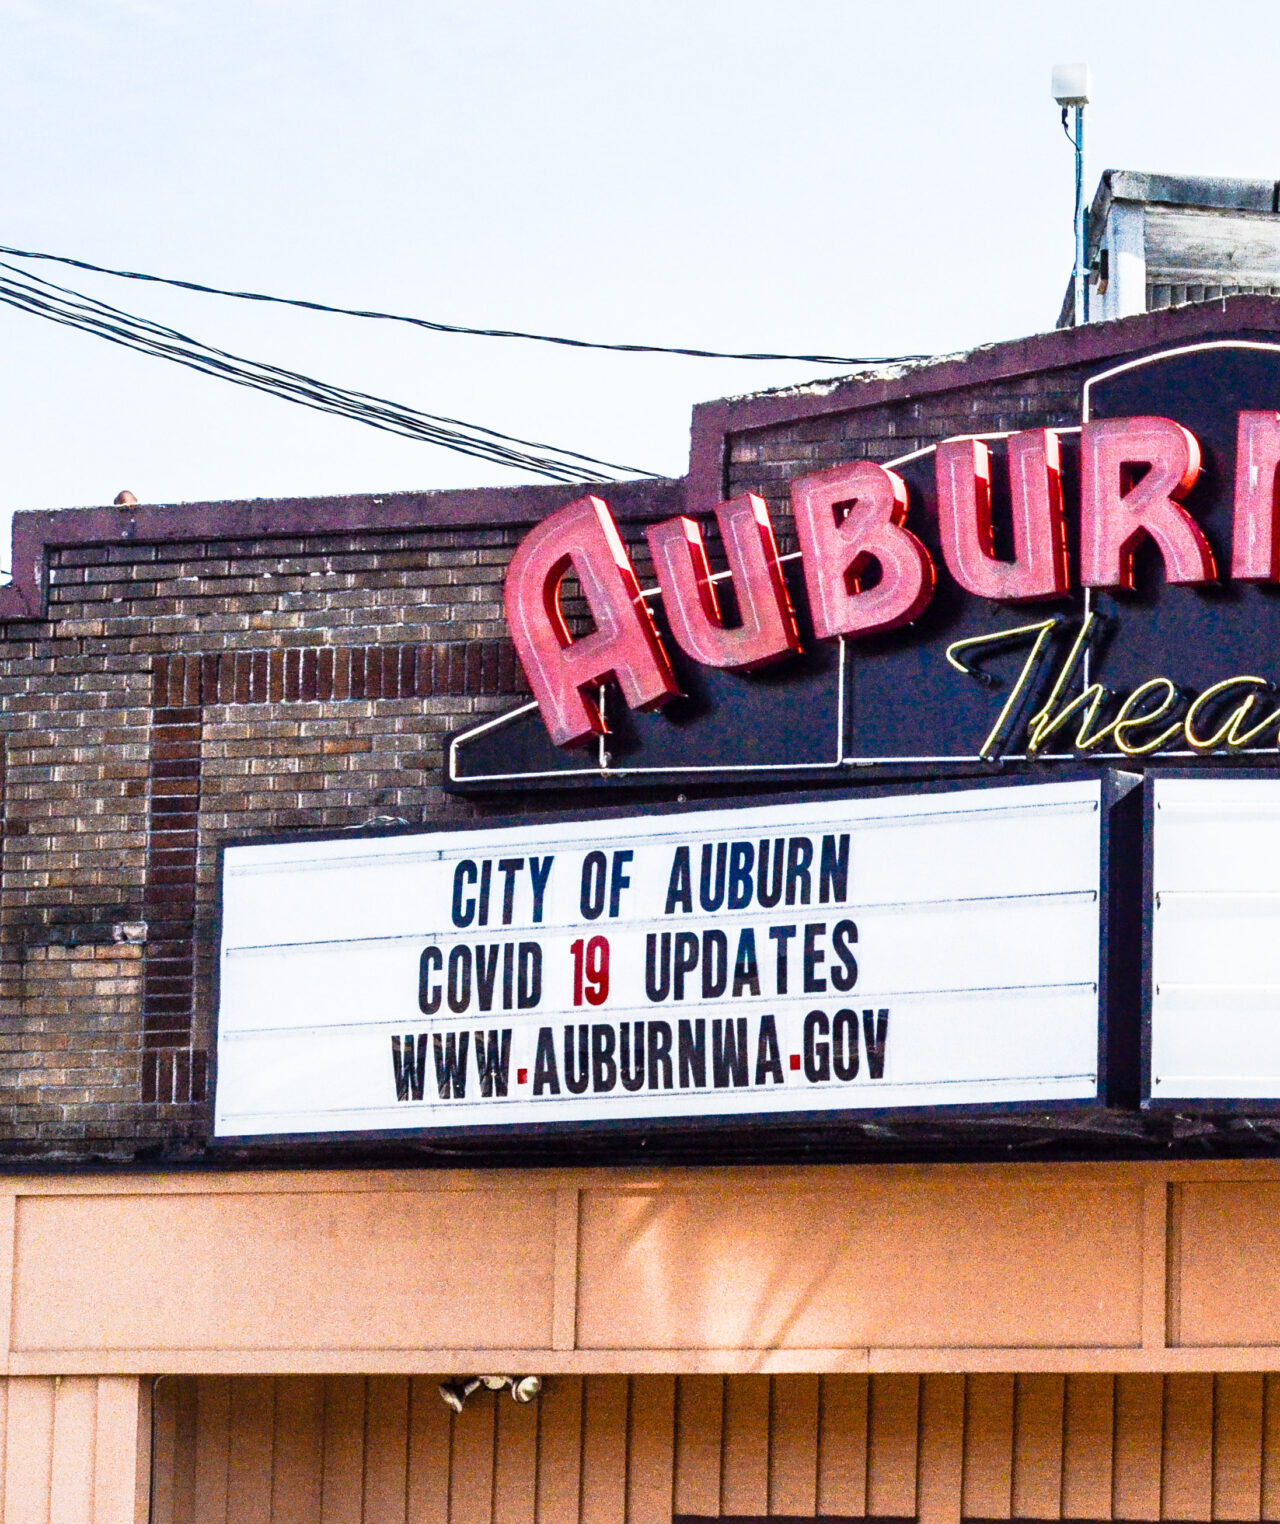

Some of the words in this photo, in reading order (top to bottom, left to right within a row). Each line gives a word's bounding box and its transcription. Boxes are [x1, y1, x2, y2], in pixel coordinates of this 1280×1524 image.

[451, 855, 555, 928] CITY
[580, 849, 634, 921] OF
[664, 833, 851, 915] AUBURN
[418, 941, 543, 1015] COVID
[570, 934, 610, 1007] 19
[645, 919, 859, 1003] UPDATES
[391, 1008, 890, 1102] WWW.AUBURNWA.GOV
